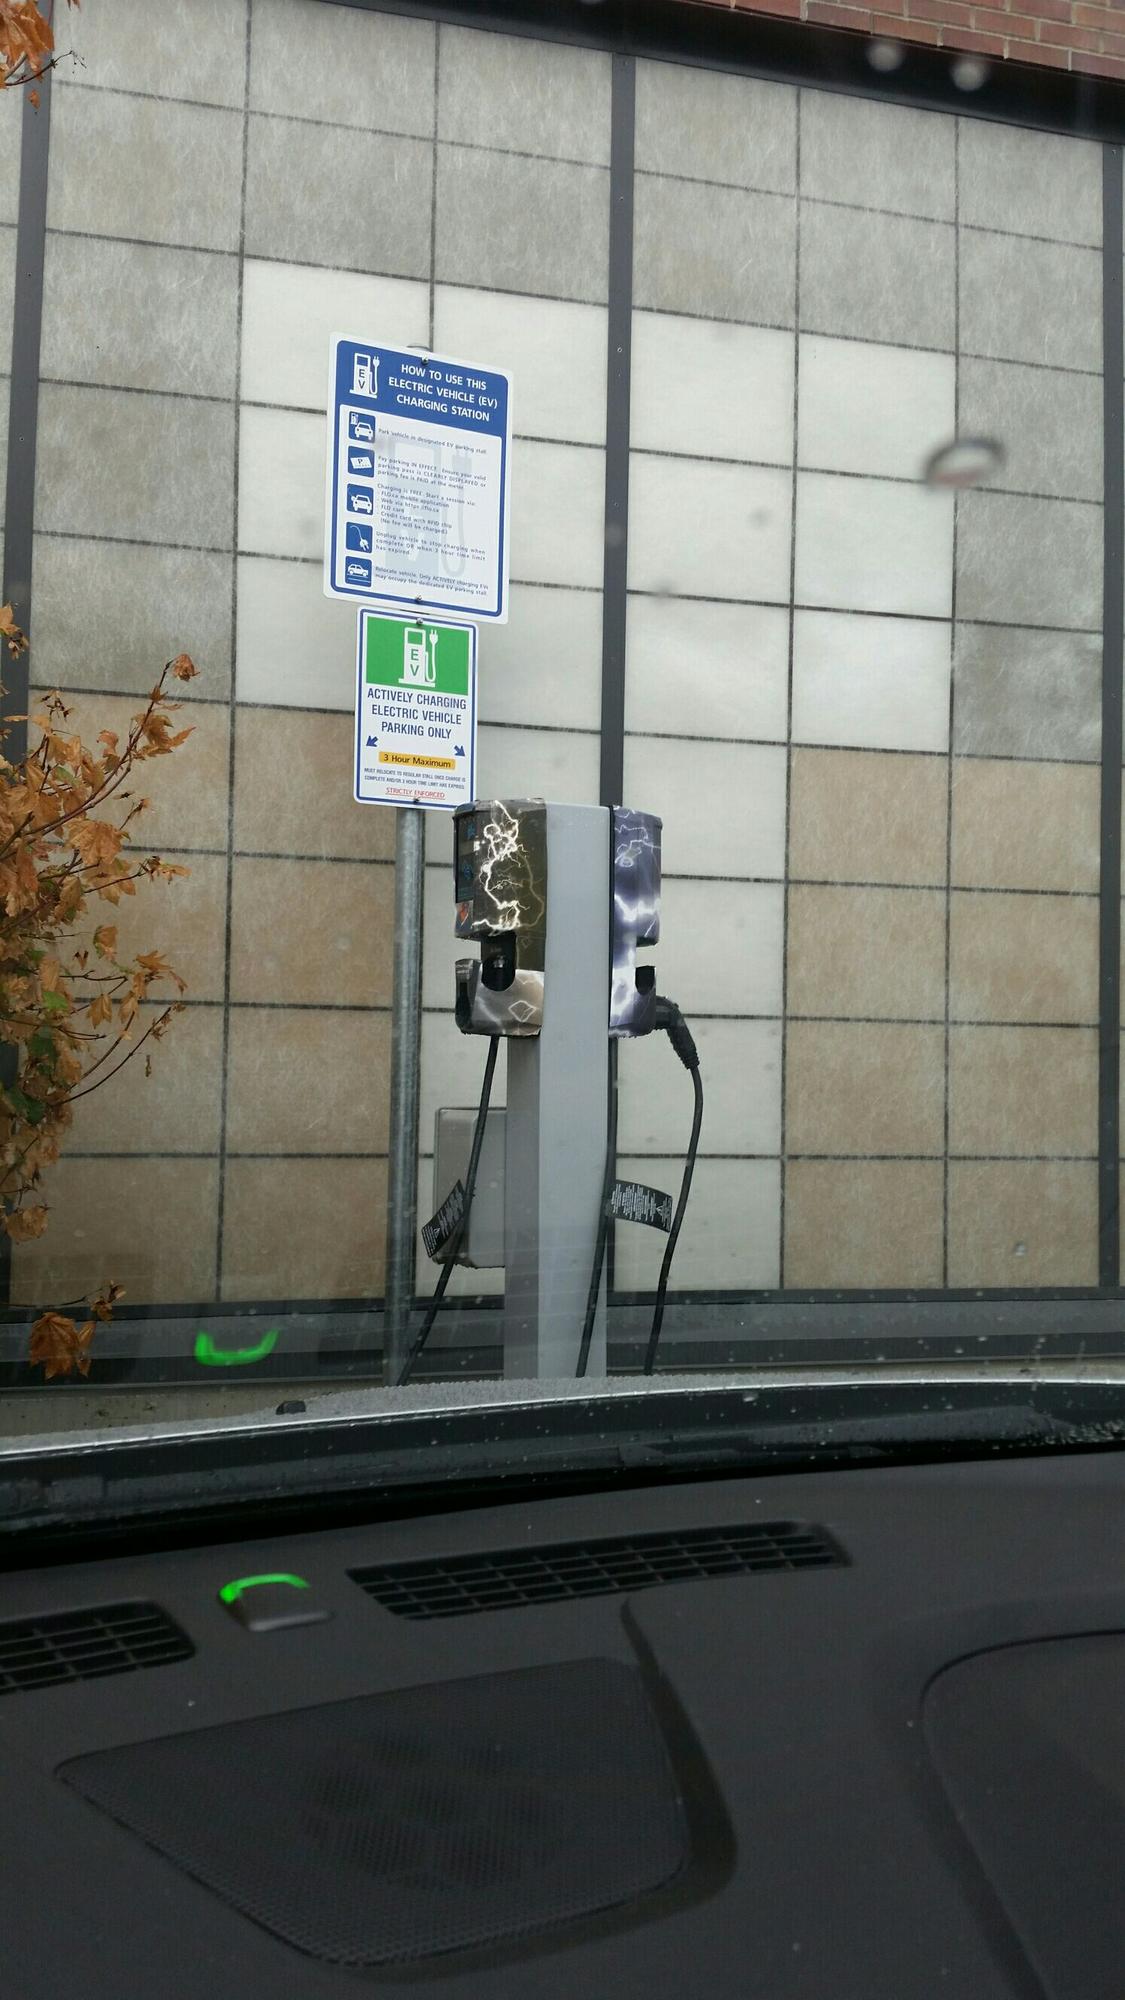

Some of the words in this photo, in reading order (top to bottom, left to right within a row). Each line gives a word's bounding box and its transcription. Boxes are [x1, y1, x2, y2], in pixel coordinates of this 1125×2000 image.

[402, 364, 425, 378] HOW
[429, 370, 442, 381] TO
[446, 372, 462, 386] USE
[467, 378, 486, 390] THIS
[389, 377, 432, 394] ELECTRIC
[437, 386, 475, 403] VEHICLE
[478, 396, 497, 409] (EV)
[397, 394, 448, 413] CHARGING
[452, 406, 490, 421] STATION
[368, 688, 413, 703] ACTIVELY
[417, 694, 466, 709] CHARGING
[372, 704, 418, 719] ELECTRIC
[422, 710, 461, 724] VEHICLE
[381, 722, 424, 736] PARKING
[428, 727, 451, 739] ONLY
[392, 755, 410, 763] Hour
[412, 757, 451, 768] Maximum
[414, 790, 445, 798] ENFORCED
